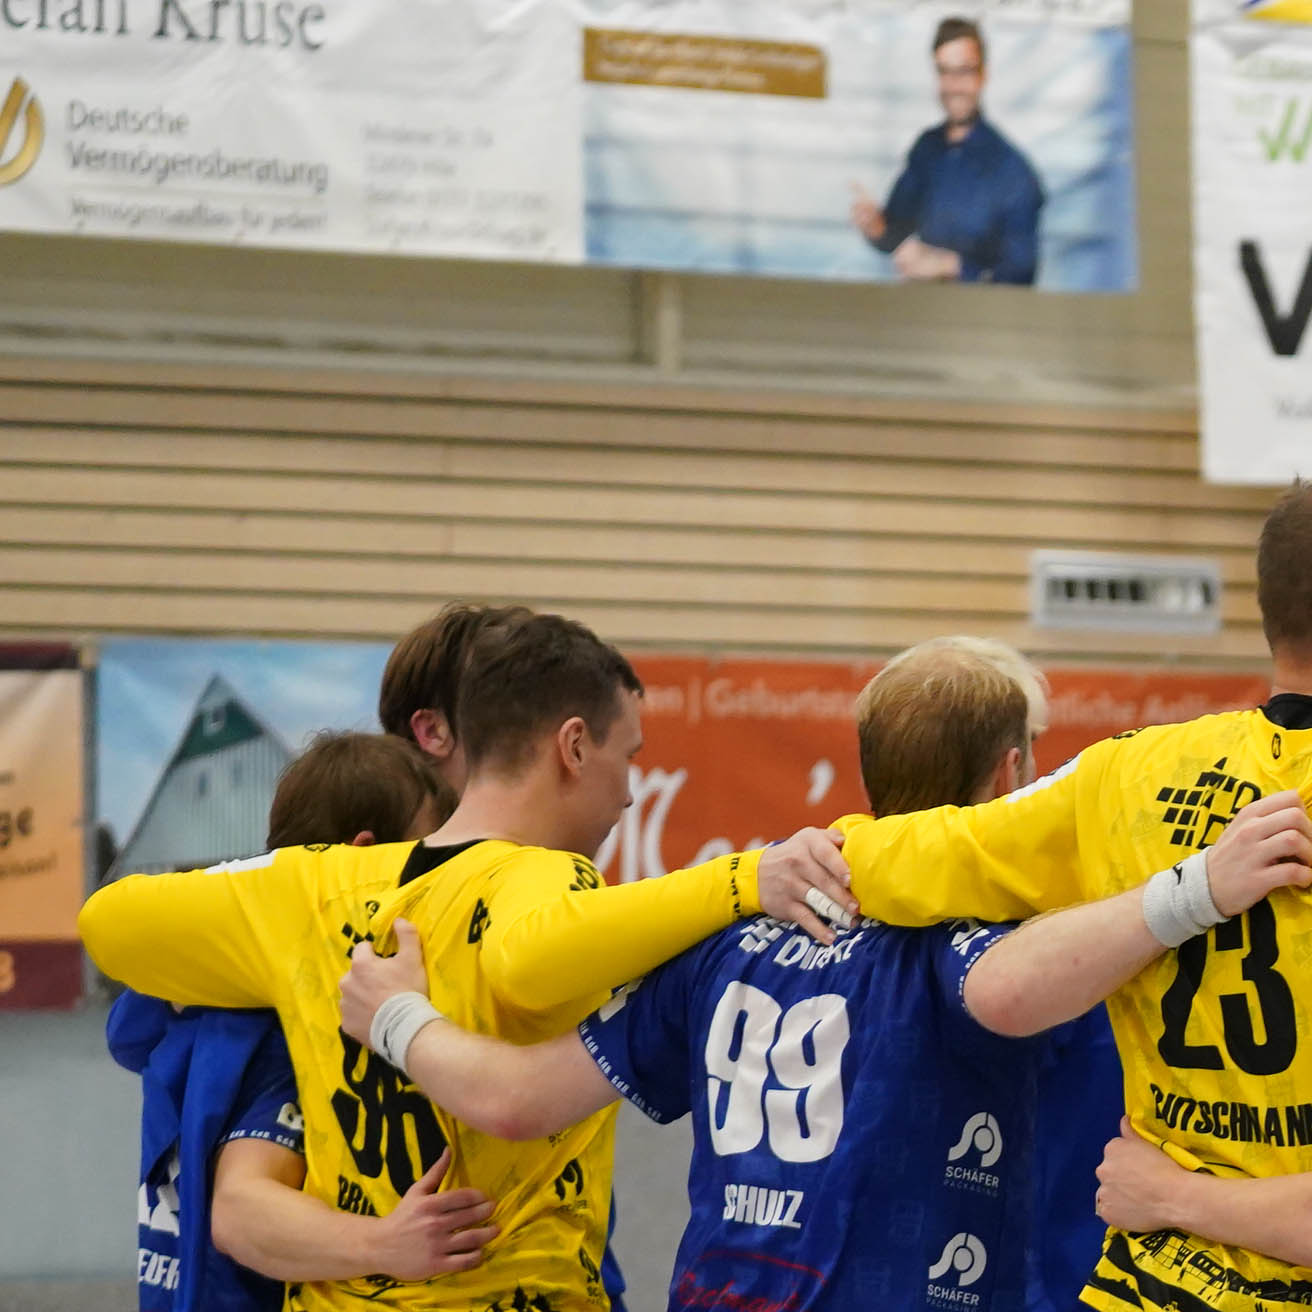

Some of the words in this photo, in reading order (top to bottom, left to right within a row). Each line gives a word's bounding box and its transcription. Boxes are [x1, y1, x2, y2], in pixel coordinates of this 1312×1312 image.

[66, 99, 191, 136] Deutsche
[65, 140, 330, 195] Vermögensberatung
[704, 979, 851, 1163] 99
[945, 1164, 1000, 1188] SCHÄFER
[926, 1282, 981, 1306] SCHÄFER
